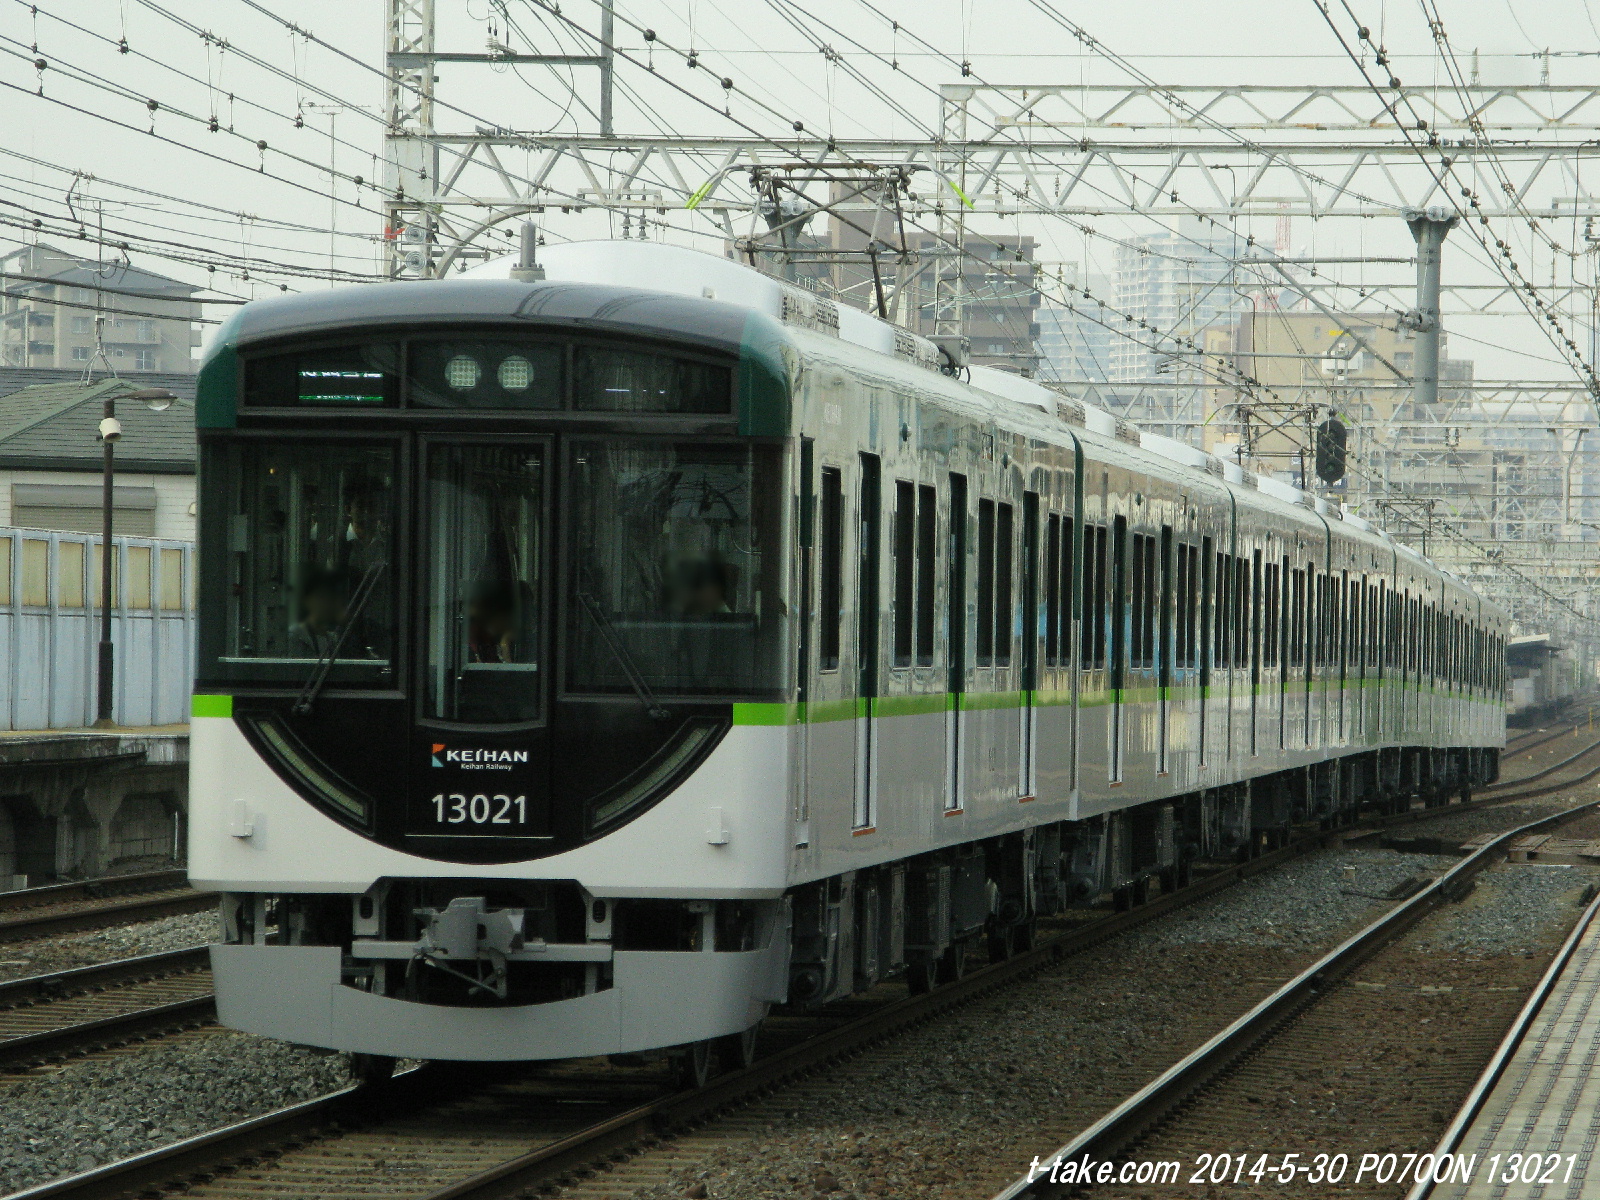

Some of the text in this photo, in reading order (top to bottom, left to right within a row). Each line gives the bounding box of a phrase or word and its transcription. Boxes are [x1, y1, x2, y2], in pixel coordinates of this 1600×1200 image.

[446, 748, 528, 762] KEIHAN
[486, 763, 512, 771] Railway
[431, 794, 526, 824] 13021
